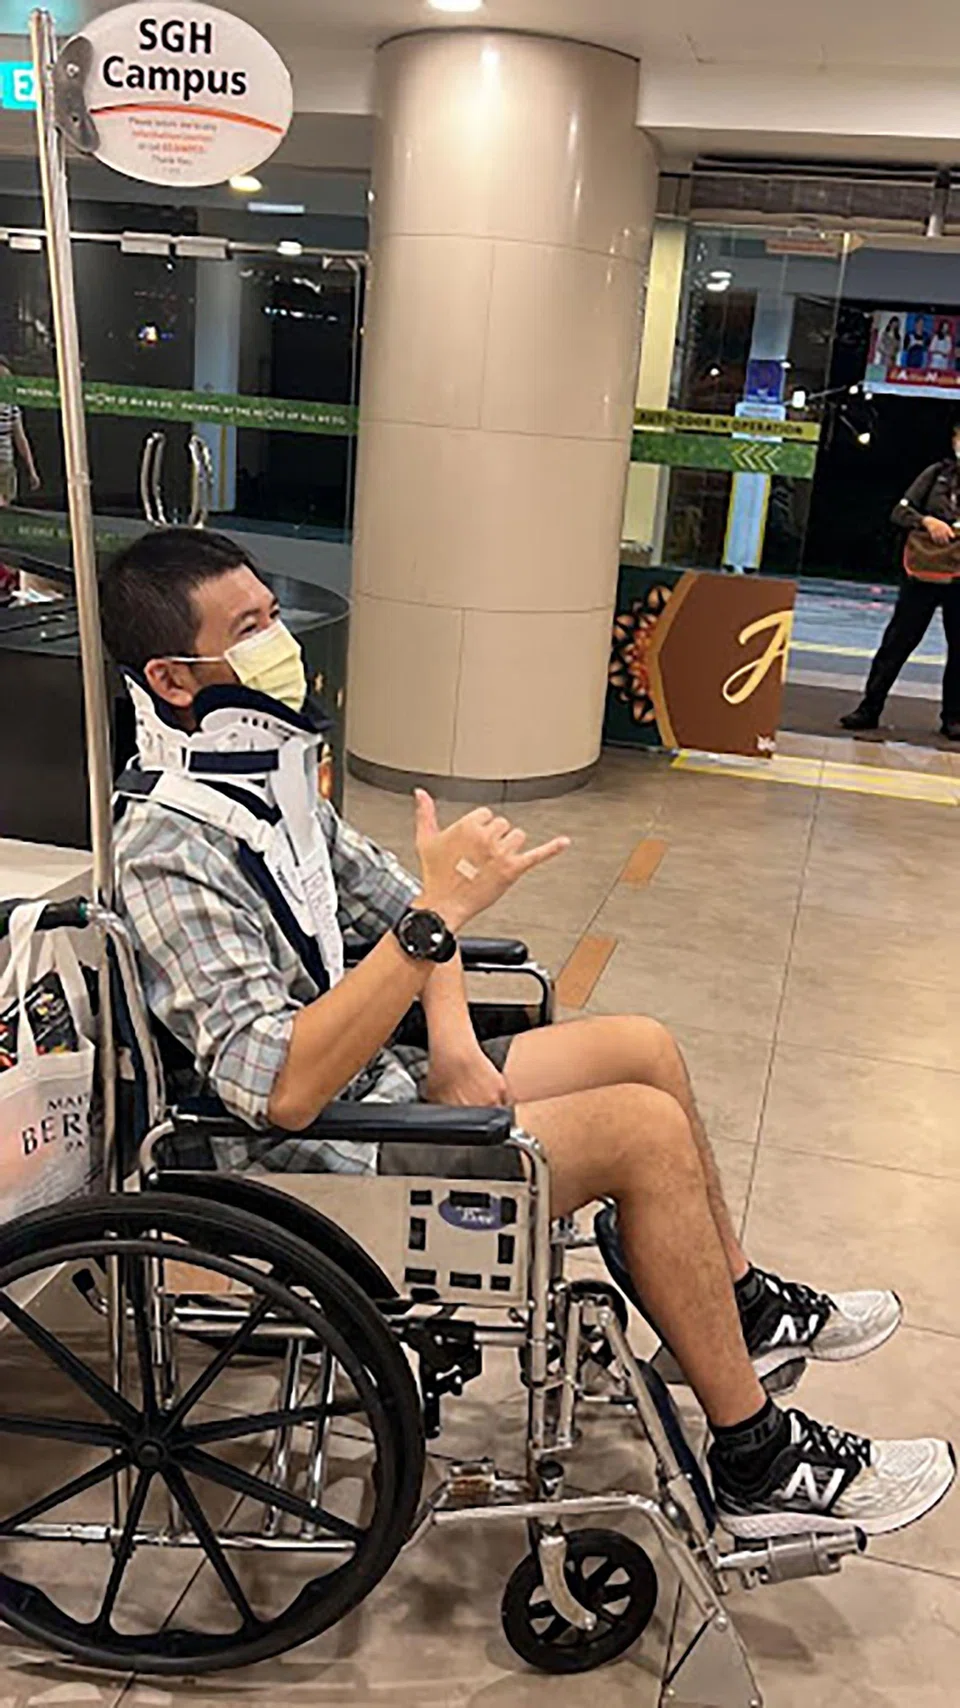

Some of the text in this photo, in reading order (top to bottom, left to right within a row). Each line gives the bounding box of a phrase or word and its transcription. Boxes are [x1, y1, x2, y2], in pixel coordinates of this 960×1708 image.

[139, 18, 212, 54] SGH
[102, 55, 248, 101] Campus
[47, 1092, 88, 1111] MAI
